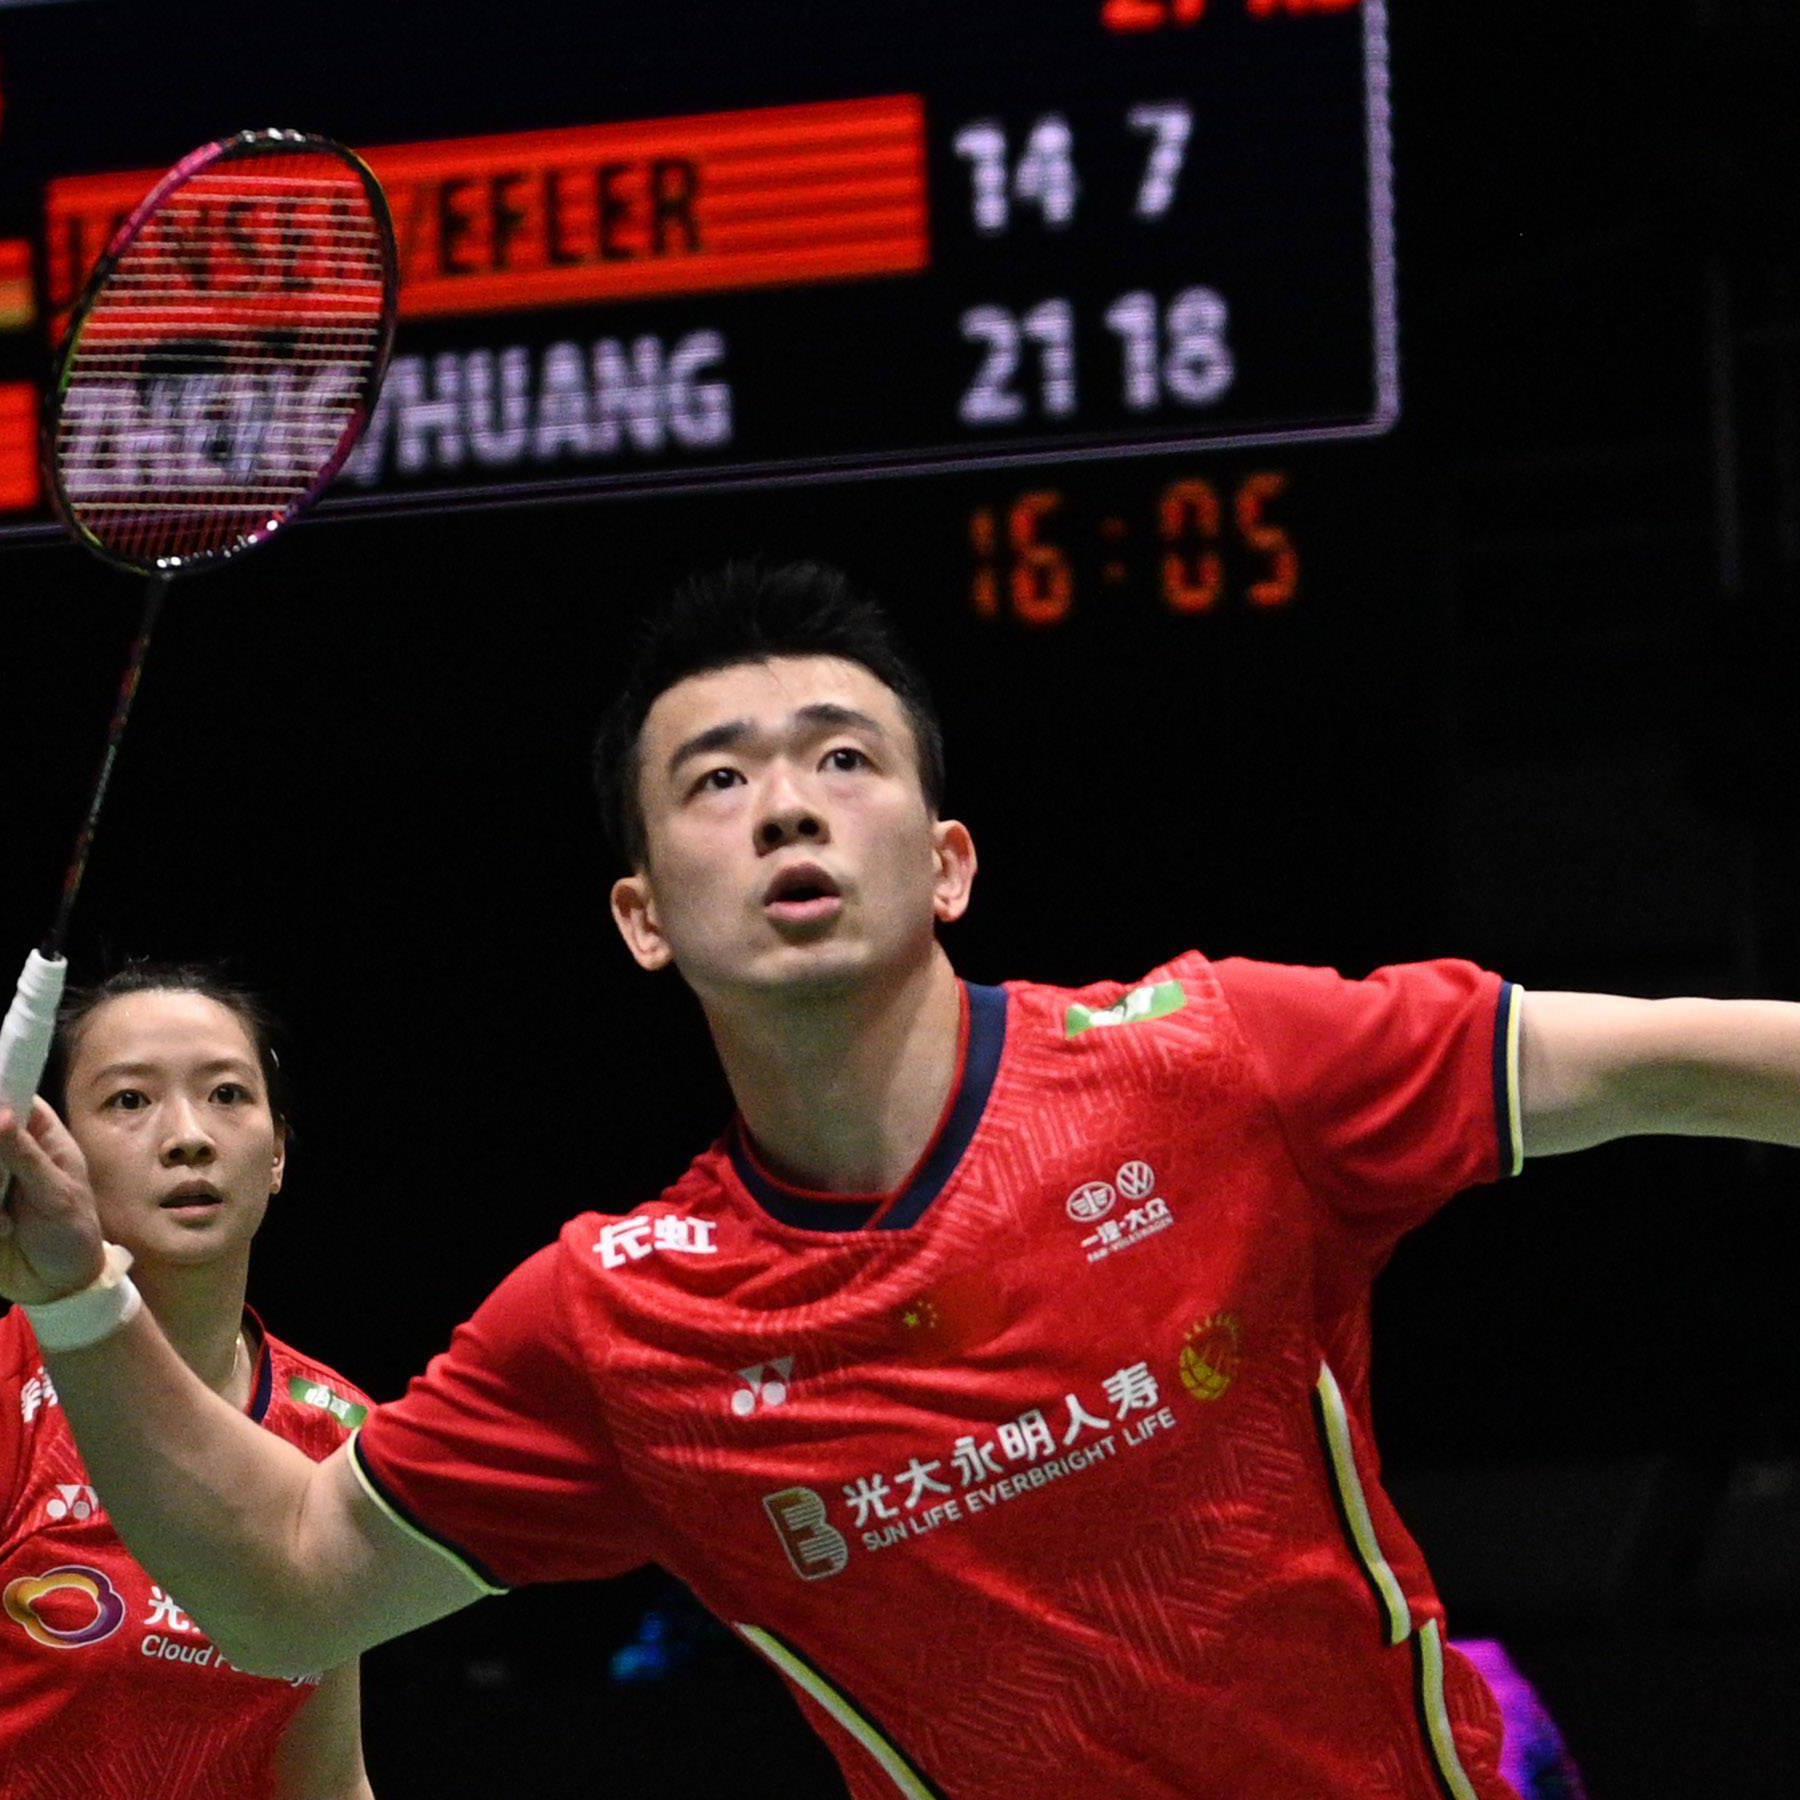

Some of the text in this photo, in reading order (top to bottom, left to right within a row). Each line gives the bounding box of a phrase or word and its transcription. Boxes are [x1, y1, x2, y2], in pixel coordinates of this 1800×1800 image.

[953, 100, 1195, 233] 14 7
[957, 284, 1236, 426] 21 18
[842, 1361, 1160, 1528] 光大永明人寿
[861, 1406, 1178, 1552] SUN LIFE EVERBRIGHT LIFE
[141, 1633, 214, 1667] Cloud
